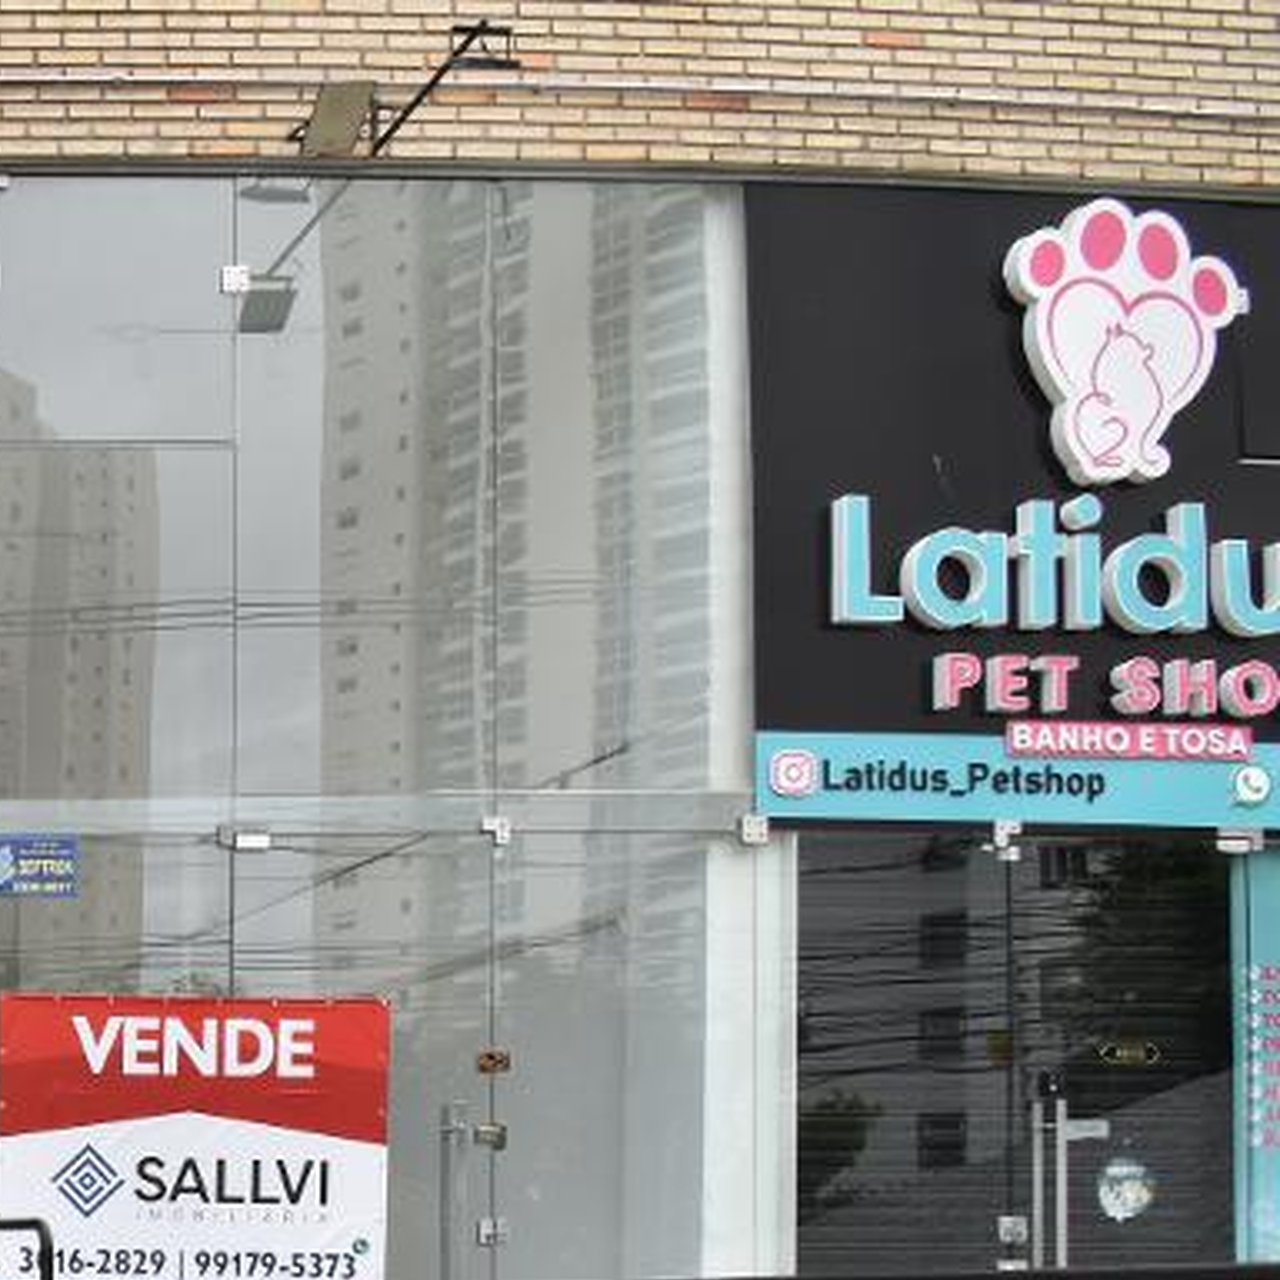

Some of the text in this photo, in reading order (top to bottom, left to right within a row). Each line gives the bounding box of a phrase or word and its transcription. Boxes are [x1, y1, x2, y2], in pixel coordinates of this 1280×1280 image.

[933, 653, 1280, 717] PET SHO
[1012, 725, 1248, 755] BANHO E TOSA
[822, 759, 1107, 804] Latidus_Petshop
[72, 1016, 315, 1079] VENDE
[134, 1155, 330, 1207] SALLVI
[19, 1246, 357, 1280] 316-2829 99179-5373
